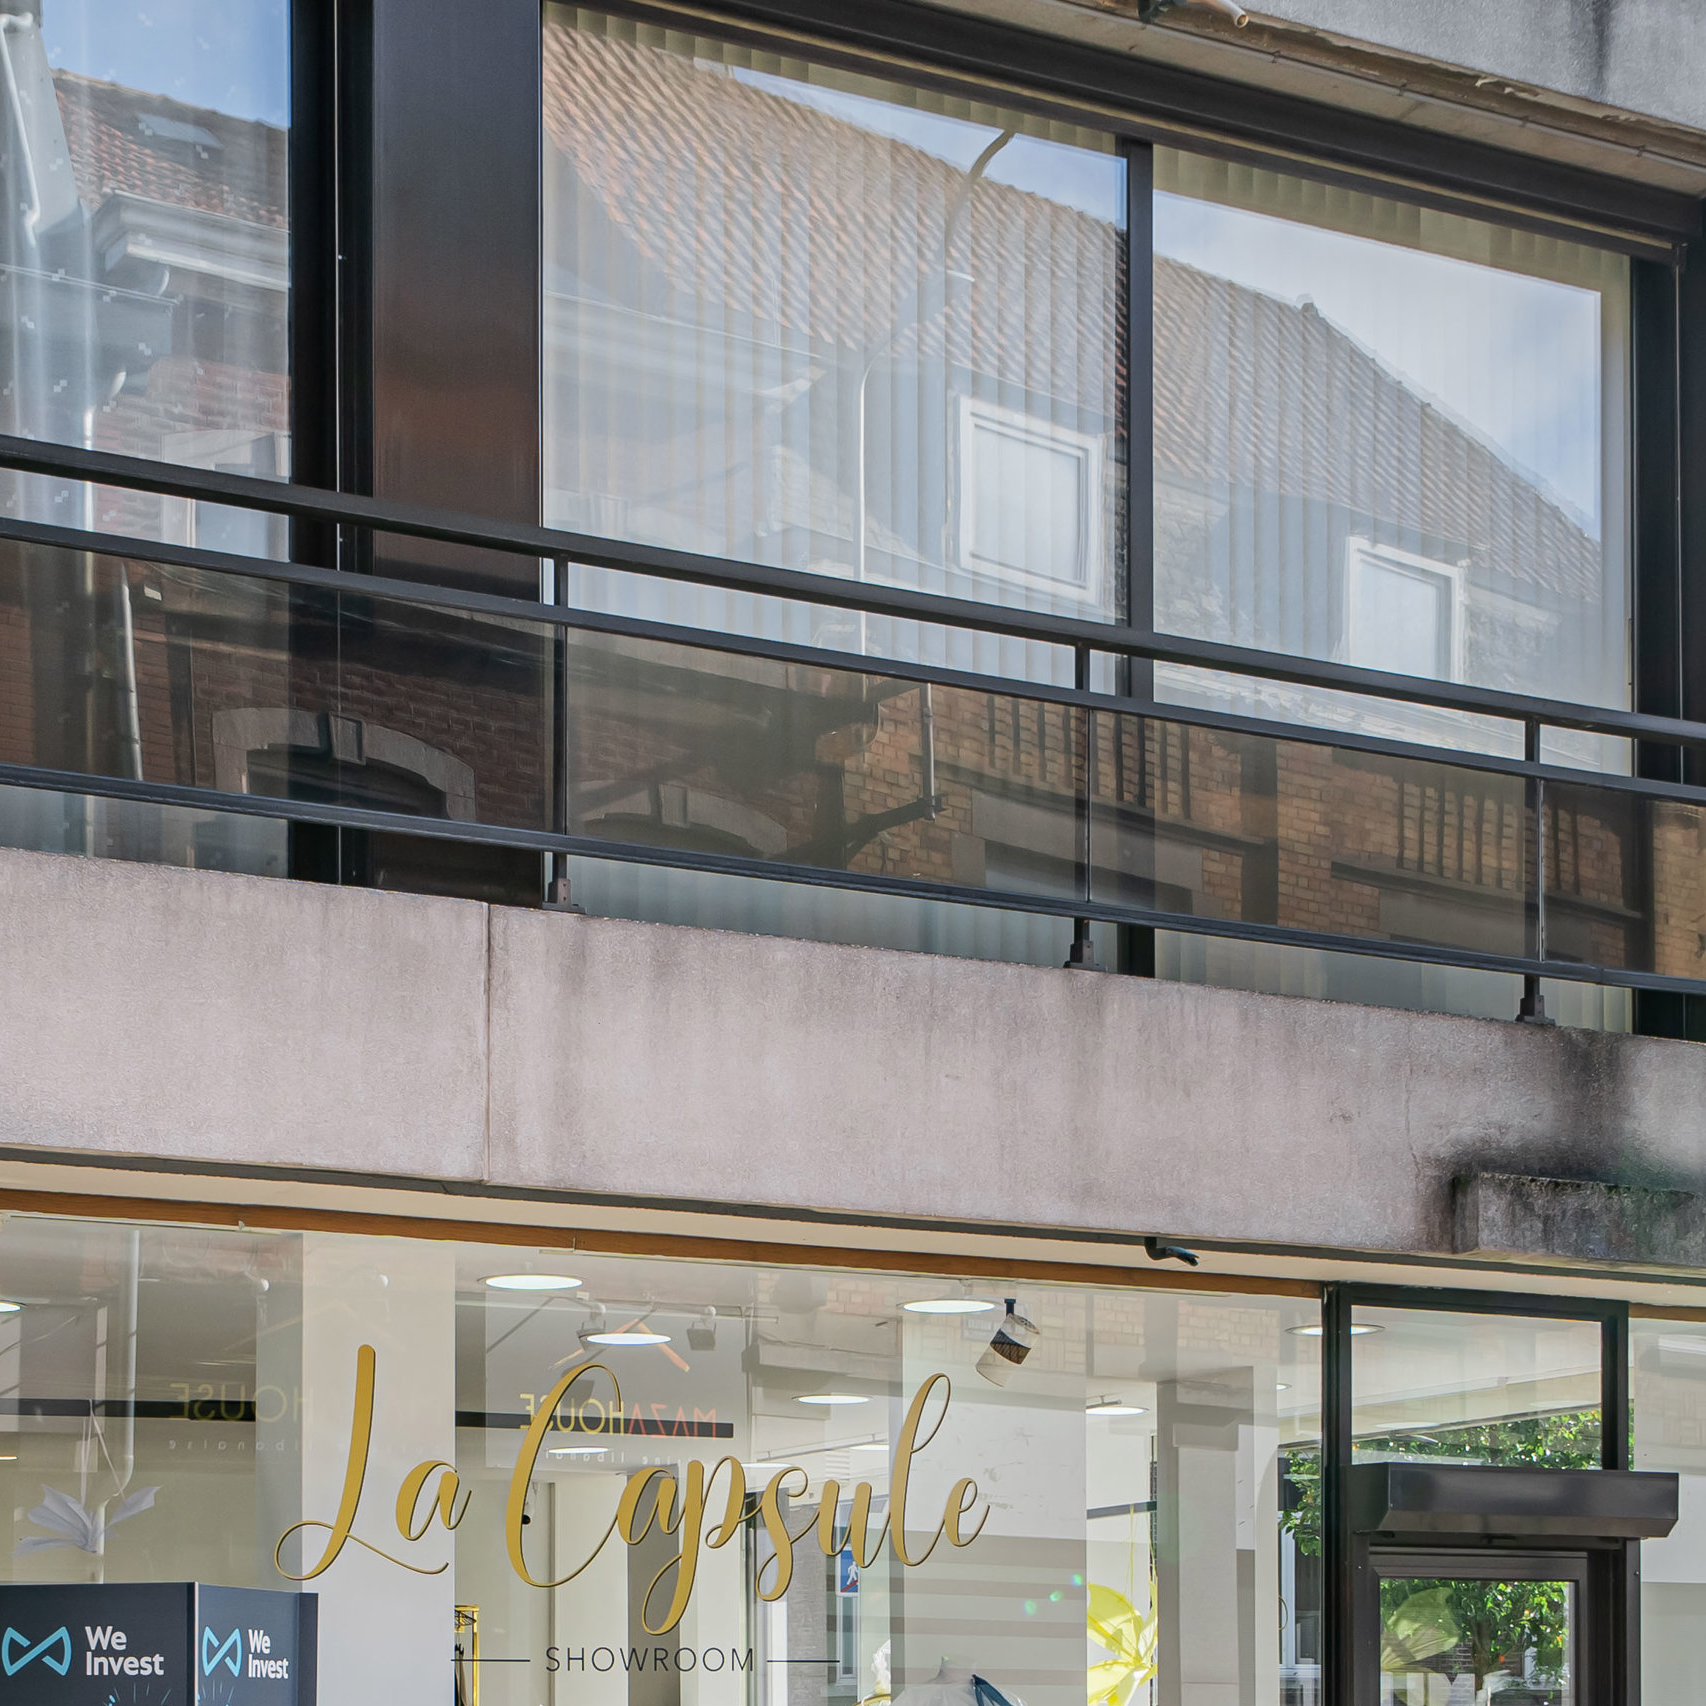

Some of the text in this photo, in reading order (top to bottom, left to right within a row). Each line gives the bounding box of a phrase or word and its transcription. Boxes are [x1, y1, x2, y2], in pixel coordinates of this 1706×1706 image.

[274, 1344, 990, 1637] La Capsule
[85, 1626, 127, 1650] We
[248, 1629, 271, 1654] We
[86, 1651, 165, 1676] Invest
[248, 1655, 289, 1679] Invest
[546, 1647, 756, 1673] SHOWROOM
